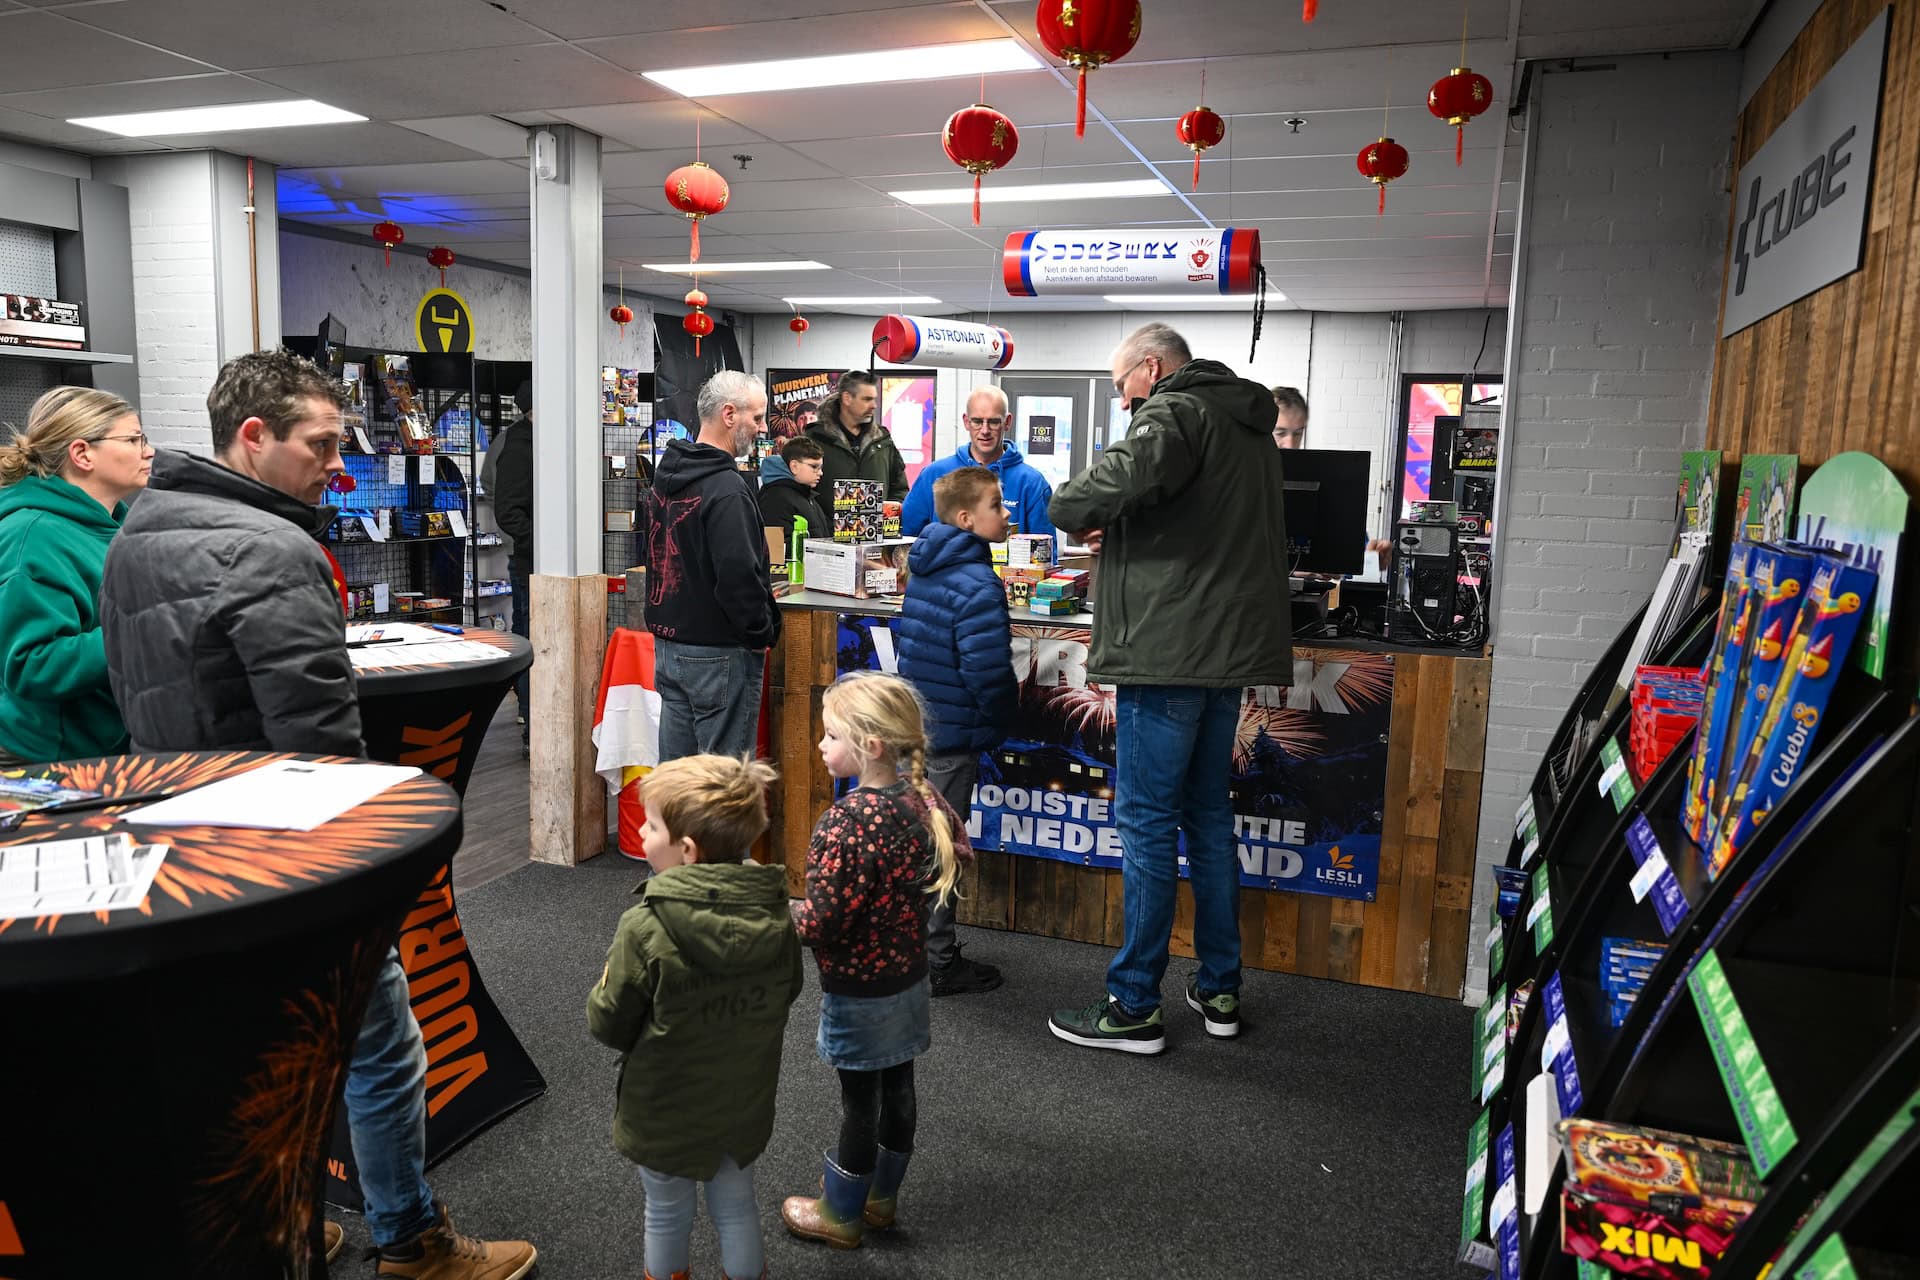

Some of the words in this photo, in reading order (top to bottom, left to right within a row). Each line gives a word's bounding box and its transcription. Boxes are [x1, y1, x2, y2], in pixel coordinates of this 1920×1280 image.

[1754, 125, 1856, 258] CUBE
[1034, 241, 1178, 262] VUURWERK
[1044, 265, 1059, 273] Niet
[1060, 265, 1067, 273] in
[1069, 265, 1078, 273] de
[1080, 265, 1098, 273] hand
[1100, 265, 1128, 273] houden
[39, 307, 73, 316] COMPOUND
[928, 328, 986, 344] ASTRONAUT
[772, 373, 829, 394] VUURWERK
[773, 384, 830, 406] PLANET.NL
[1032, 426, 1052, 435] TOT
[1032, 435, 1052, 443] ZIENS
[1771, 702, 1819, 787] Celebr8
[971, 783, 1109, 822] OOISTE
[1316, 867, 1363, 885] LESLI
[1600, 1222, 1702, 1269] MIX
